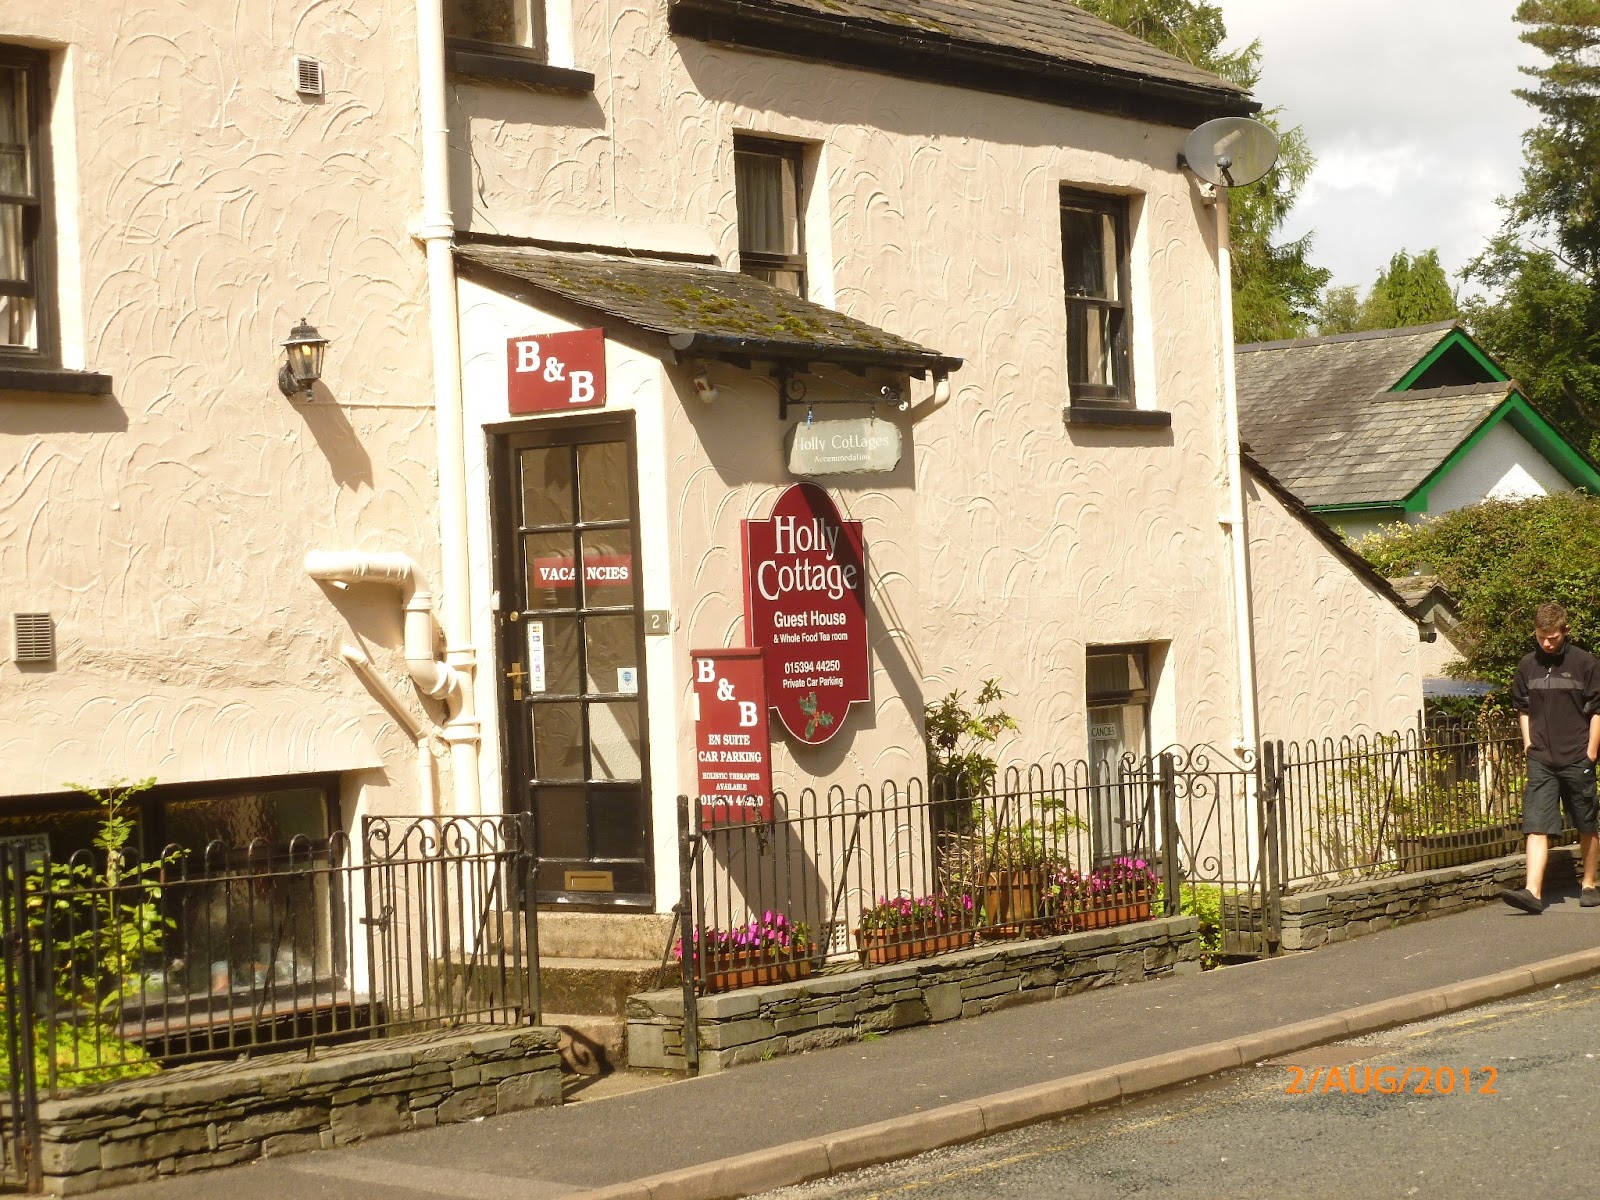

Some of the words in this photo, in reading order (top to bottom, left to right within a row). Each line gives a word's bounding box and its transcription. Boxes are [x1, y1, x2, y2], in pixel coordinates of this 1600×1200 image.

[795, 436, 826, 452] Holly
[831, 434, 889, 451] Cottages
[814, 453, 872, 464] Accommodation
[773, 515, 840, 561] Holly
[757, 557, 858, 600] Cottage
[651, 614, 661, 629] 2
[773, 611, 808, 628] Guest
[810, 610, 847, 626] House
[773, 633, 779, 644] &
[780, 633, 801, 643] Whole
[801, 632, 818, 643] Food
[819, 631, 830, 642] Tea
[831, 632, 848, 641] room
[784, 661, 814, 674] 015394
[815, 660, 841, 672] 44250
[782, 678, 806, 689] Private
[806, 677, 818, 688] Car
[819, 676, 844, 688] Parking
[708, 734, 721, 745] EN
[723, 734, 751, 746] SUITE
[698, 751, 719, 763] CAR
[720, 751, 763, 763] PARKING
[702, 772, 728, 780] HOLISTIC
[729, 772, 760, 780] THERAPIES
[715, 783, 748, 791] AVAILABLE
